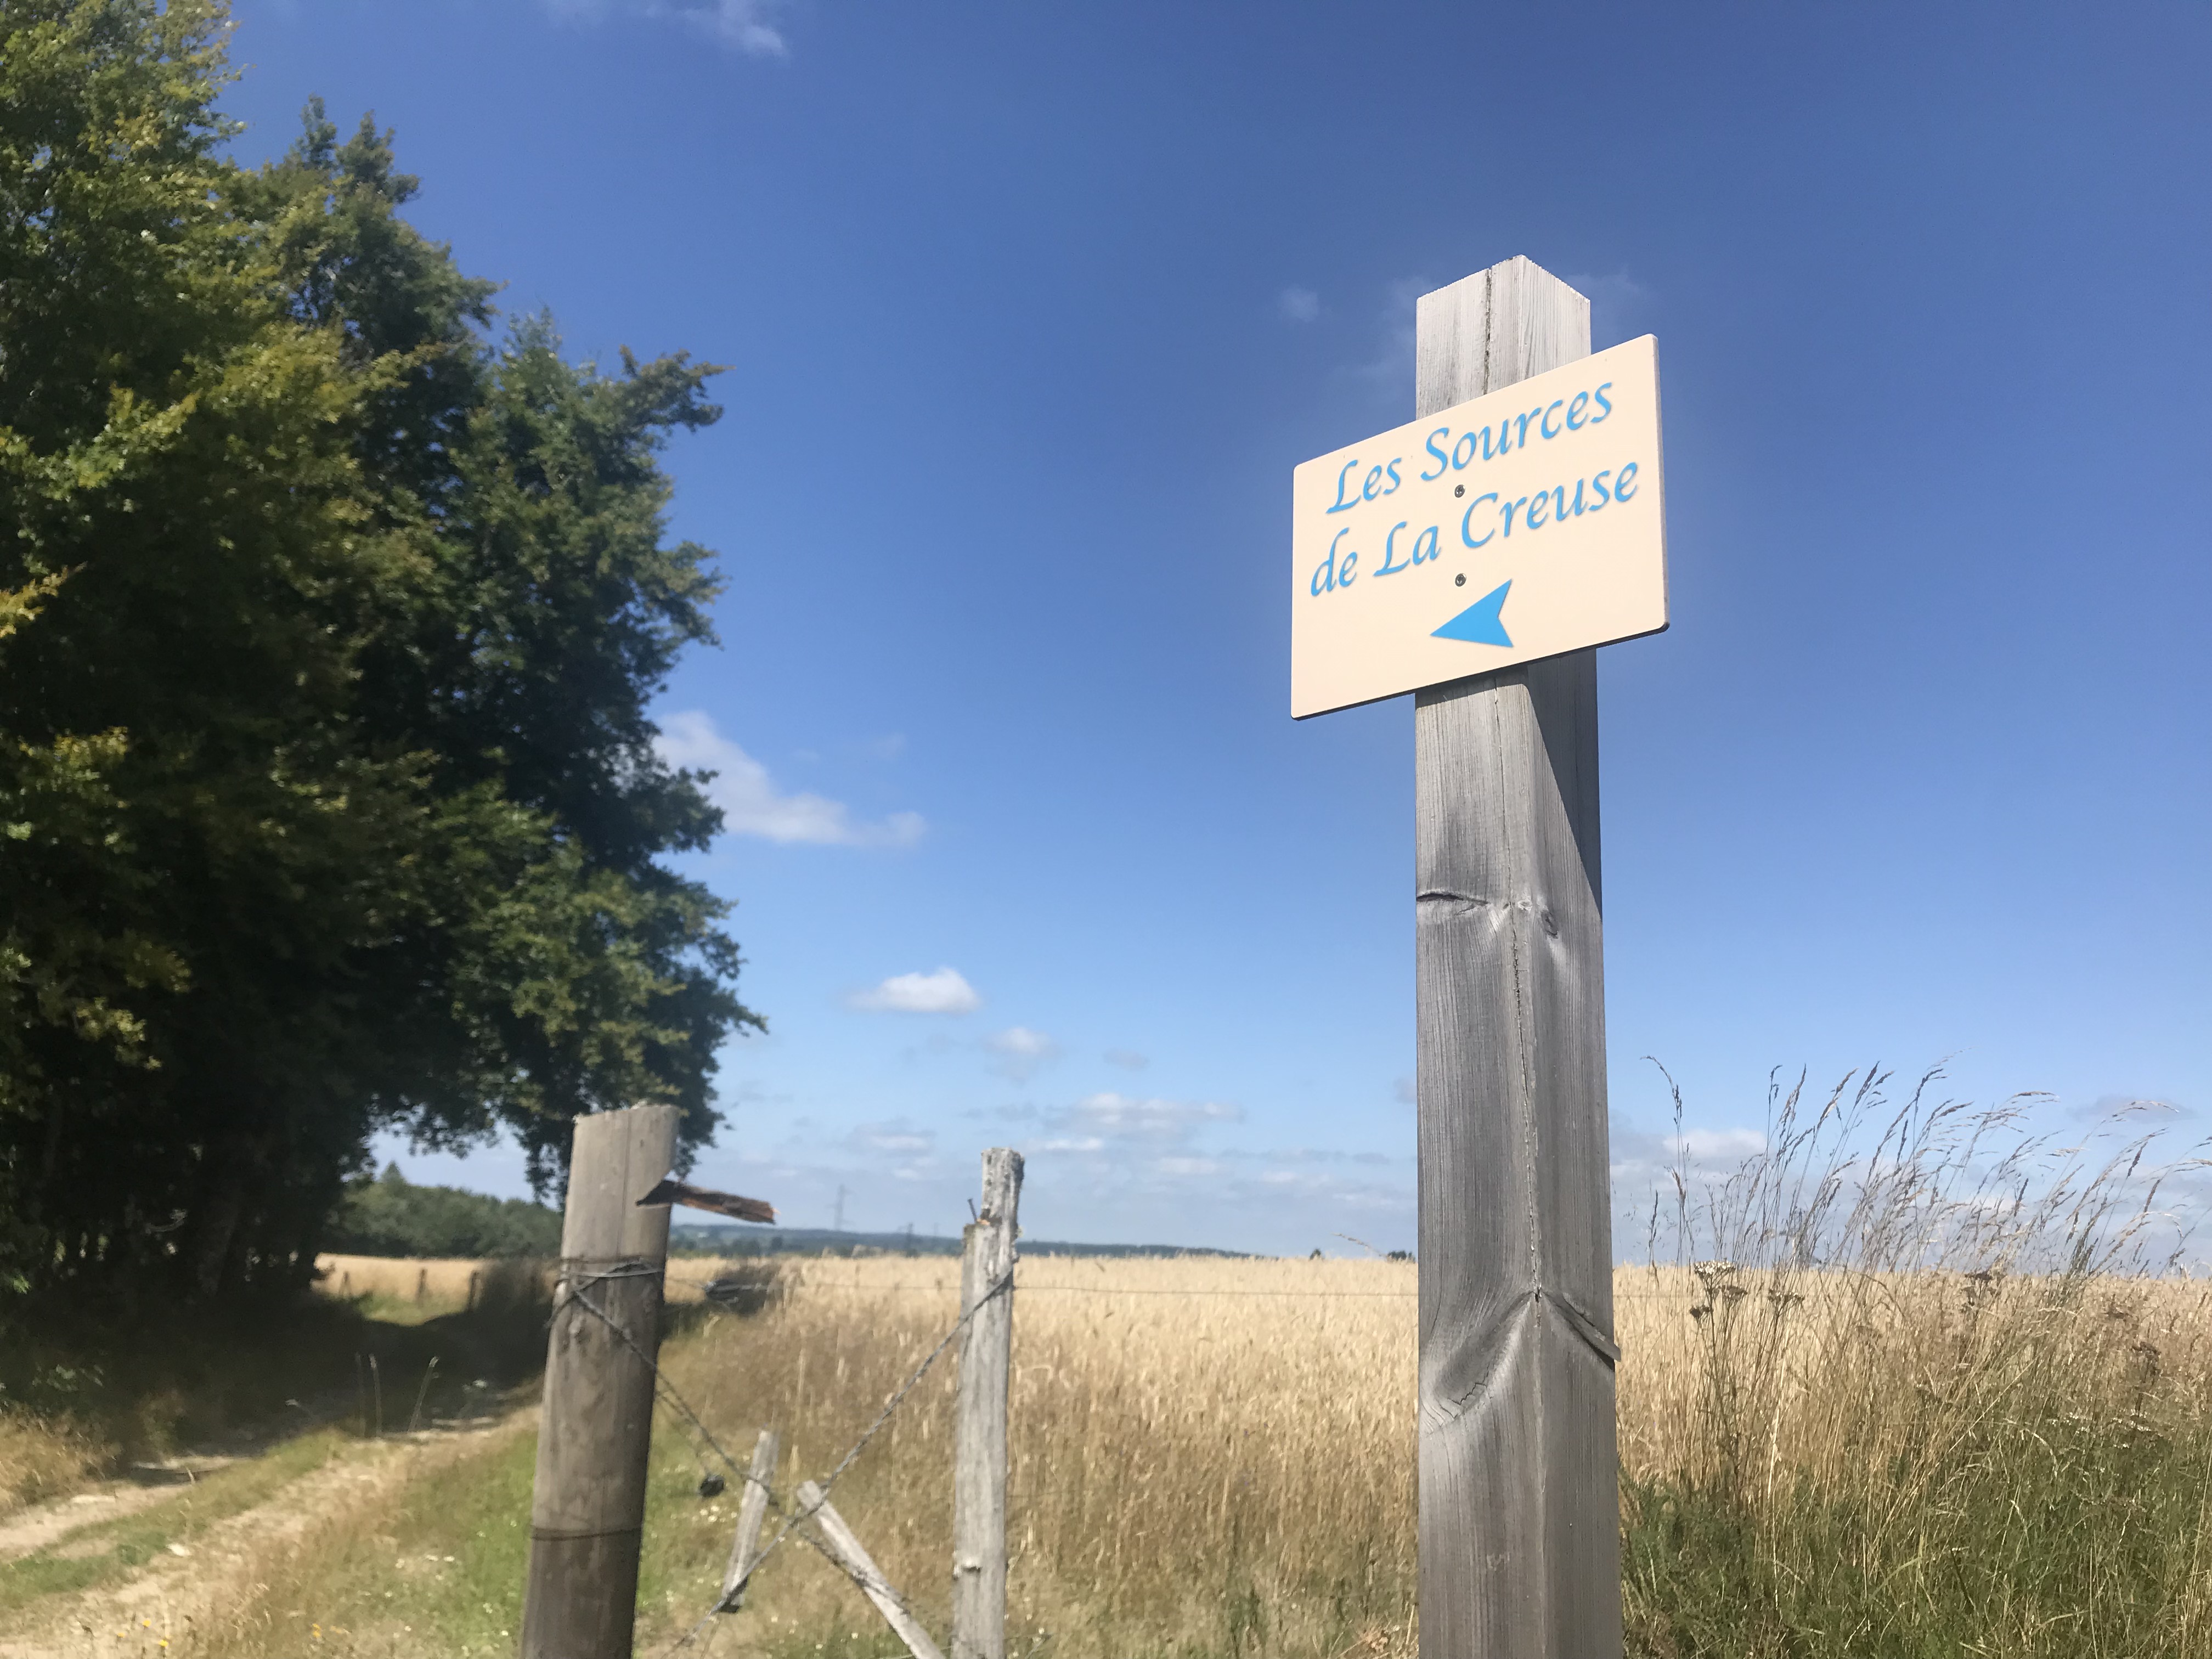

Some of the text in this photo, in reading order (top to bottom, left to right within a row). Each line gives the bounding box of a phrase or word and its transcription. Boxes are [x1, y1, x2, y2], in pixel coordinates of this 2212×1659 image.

[1325, 382, 1612, 514] Les Sources
[1310, 461, 1638, 596] de La Creuse
